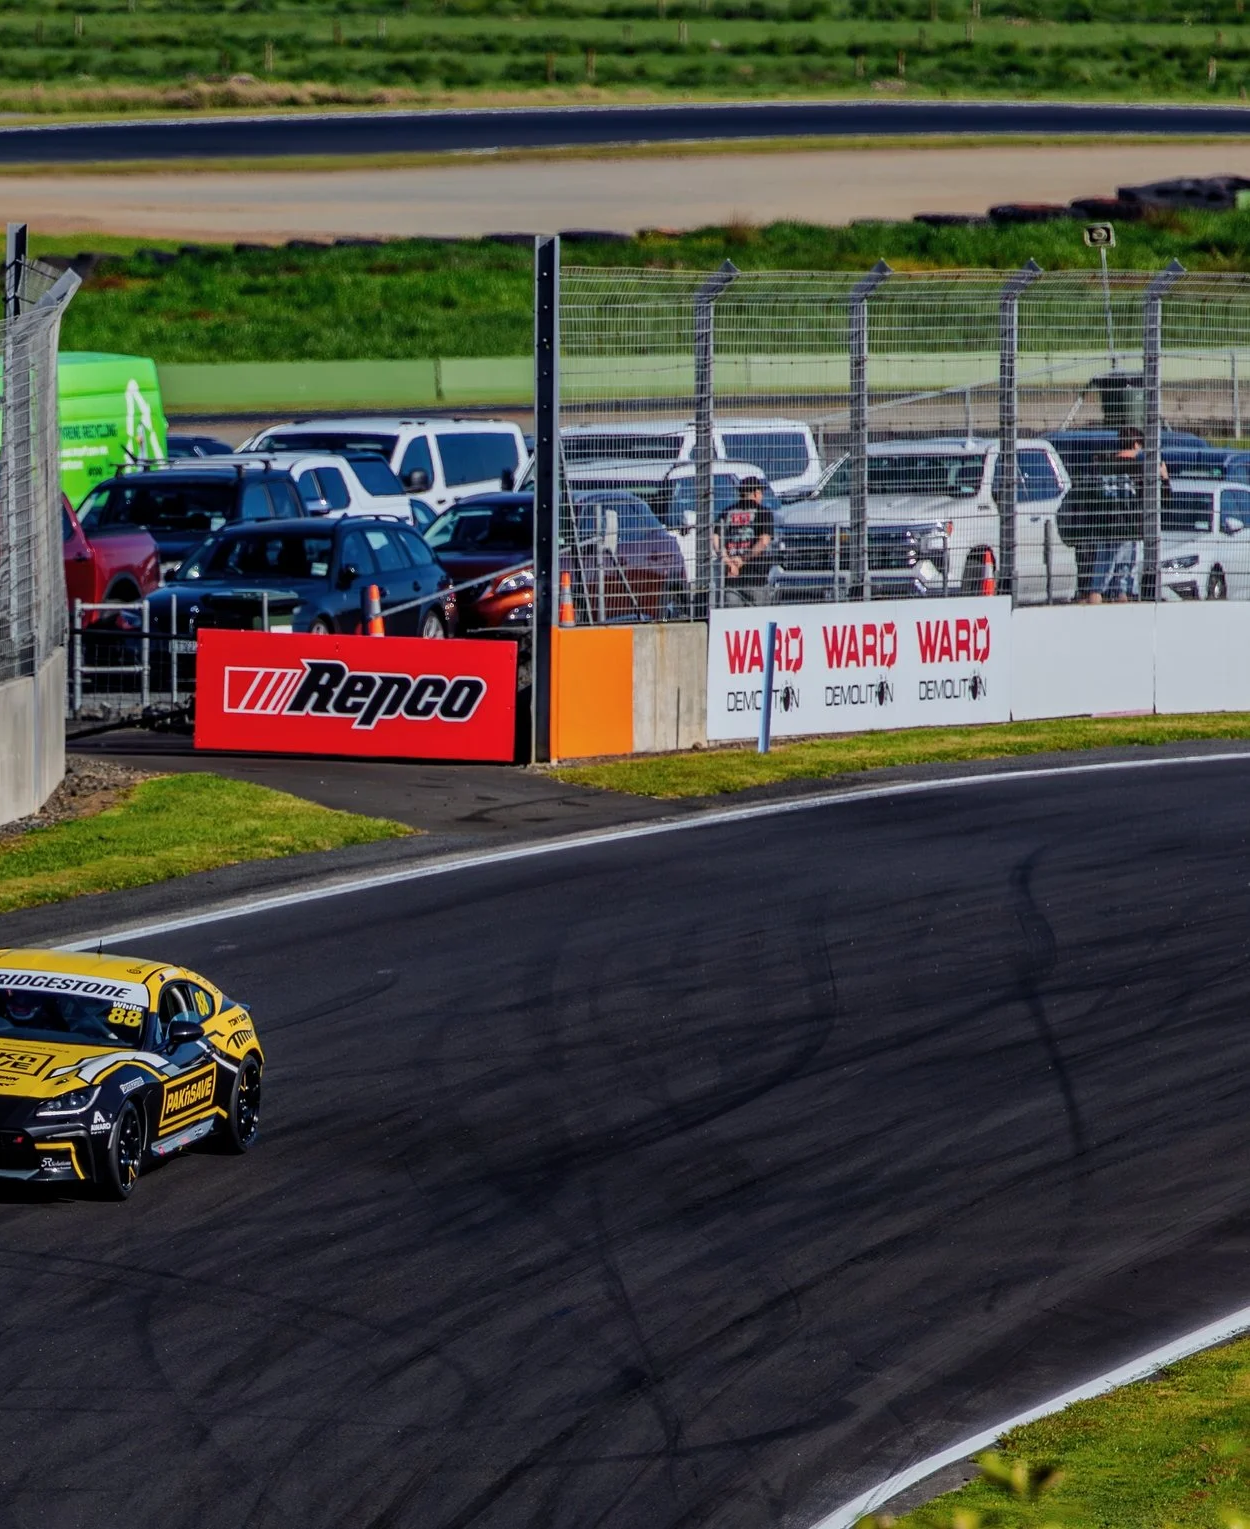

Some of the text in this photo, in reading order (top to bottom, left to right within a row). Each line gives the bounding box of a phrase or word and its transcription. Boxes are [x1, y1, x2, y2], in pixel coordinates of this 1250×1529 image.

[822, 621, 897, 670] WARD
[916, 616, 990, 664] WARD
[281, 659, 487, 730] Repco
[107, 1008, 143, 1028] 88
